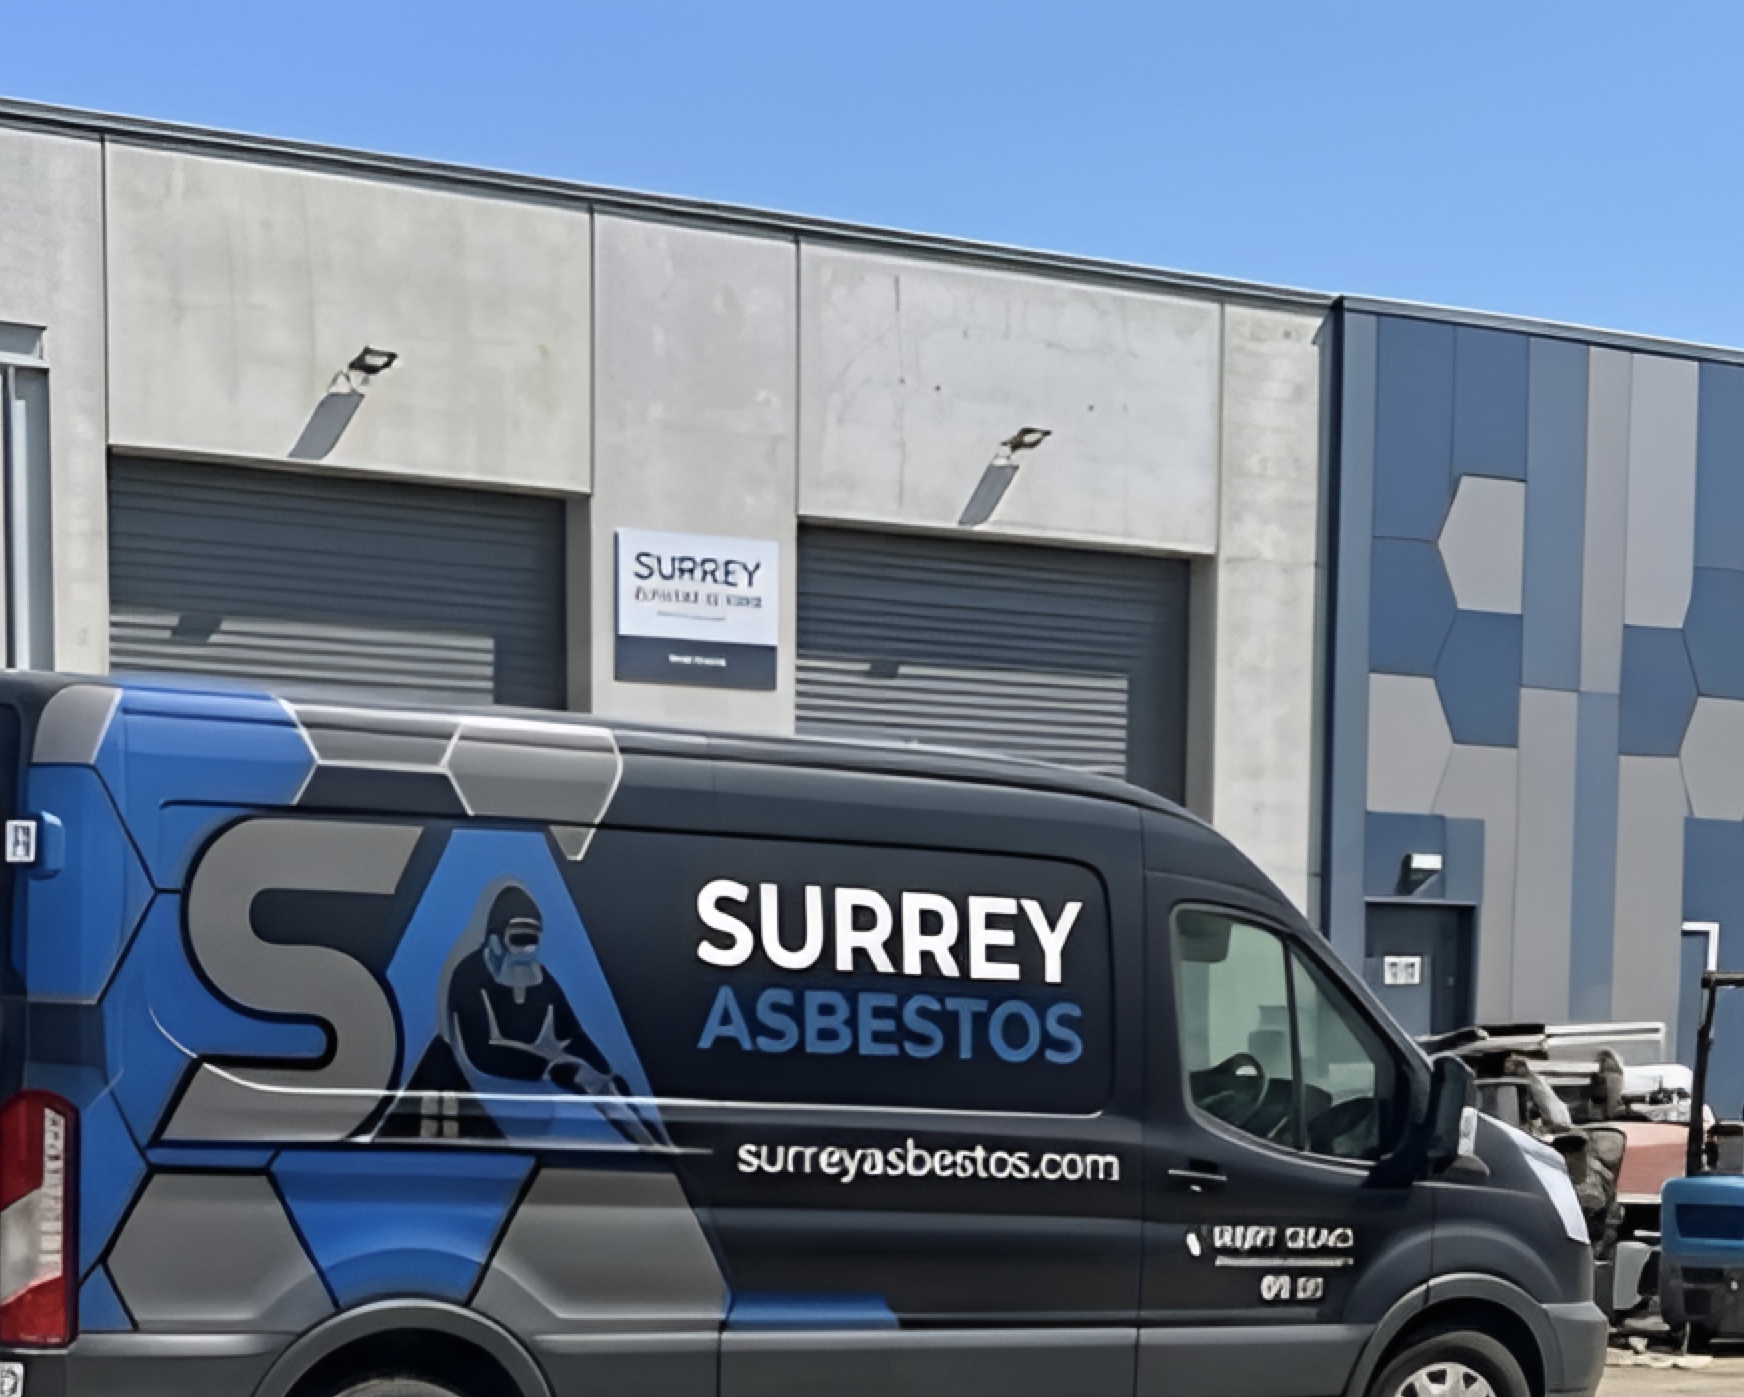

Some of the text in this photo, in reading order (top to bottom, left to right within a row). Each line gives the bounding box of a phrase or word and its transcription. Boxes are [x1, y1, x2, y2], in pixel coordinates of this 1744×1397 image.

[633, 551, 761, 588] SURREY
[696, 879, 1083, 983] SURREY
[696, 984, 1084, 1066] ASBESTOS
[737, 1136, 1121, 1184] surreyasbestos.com
